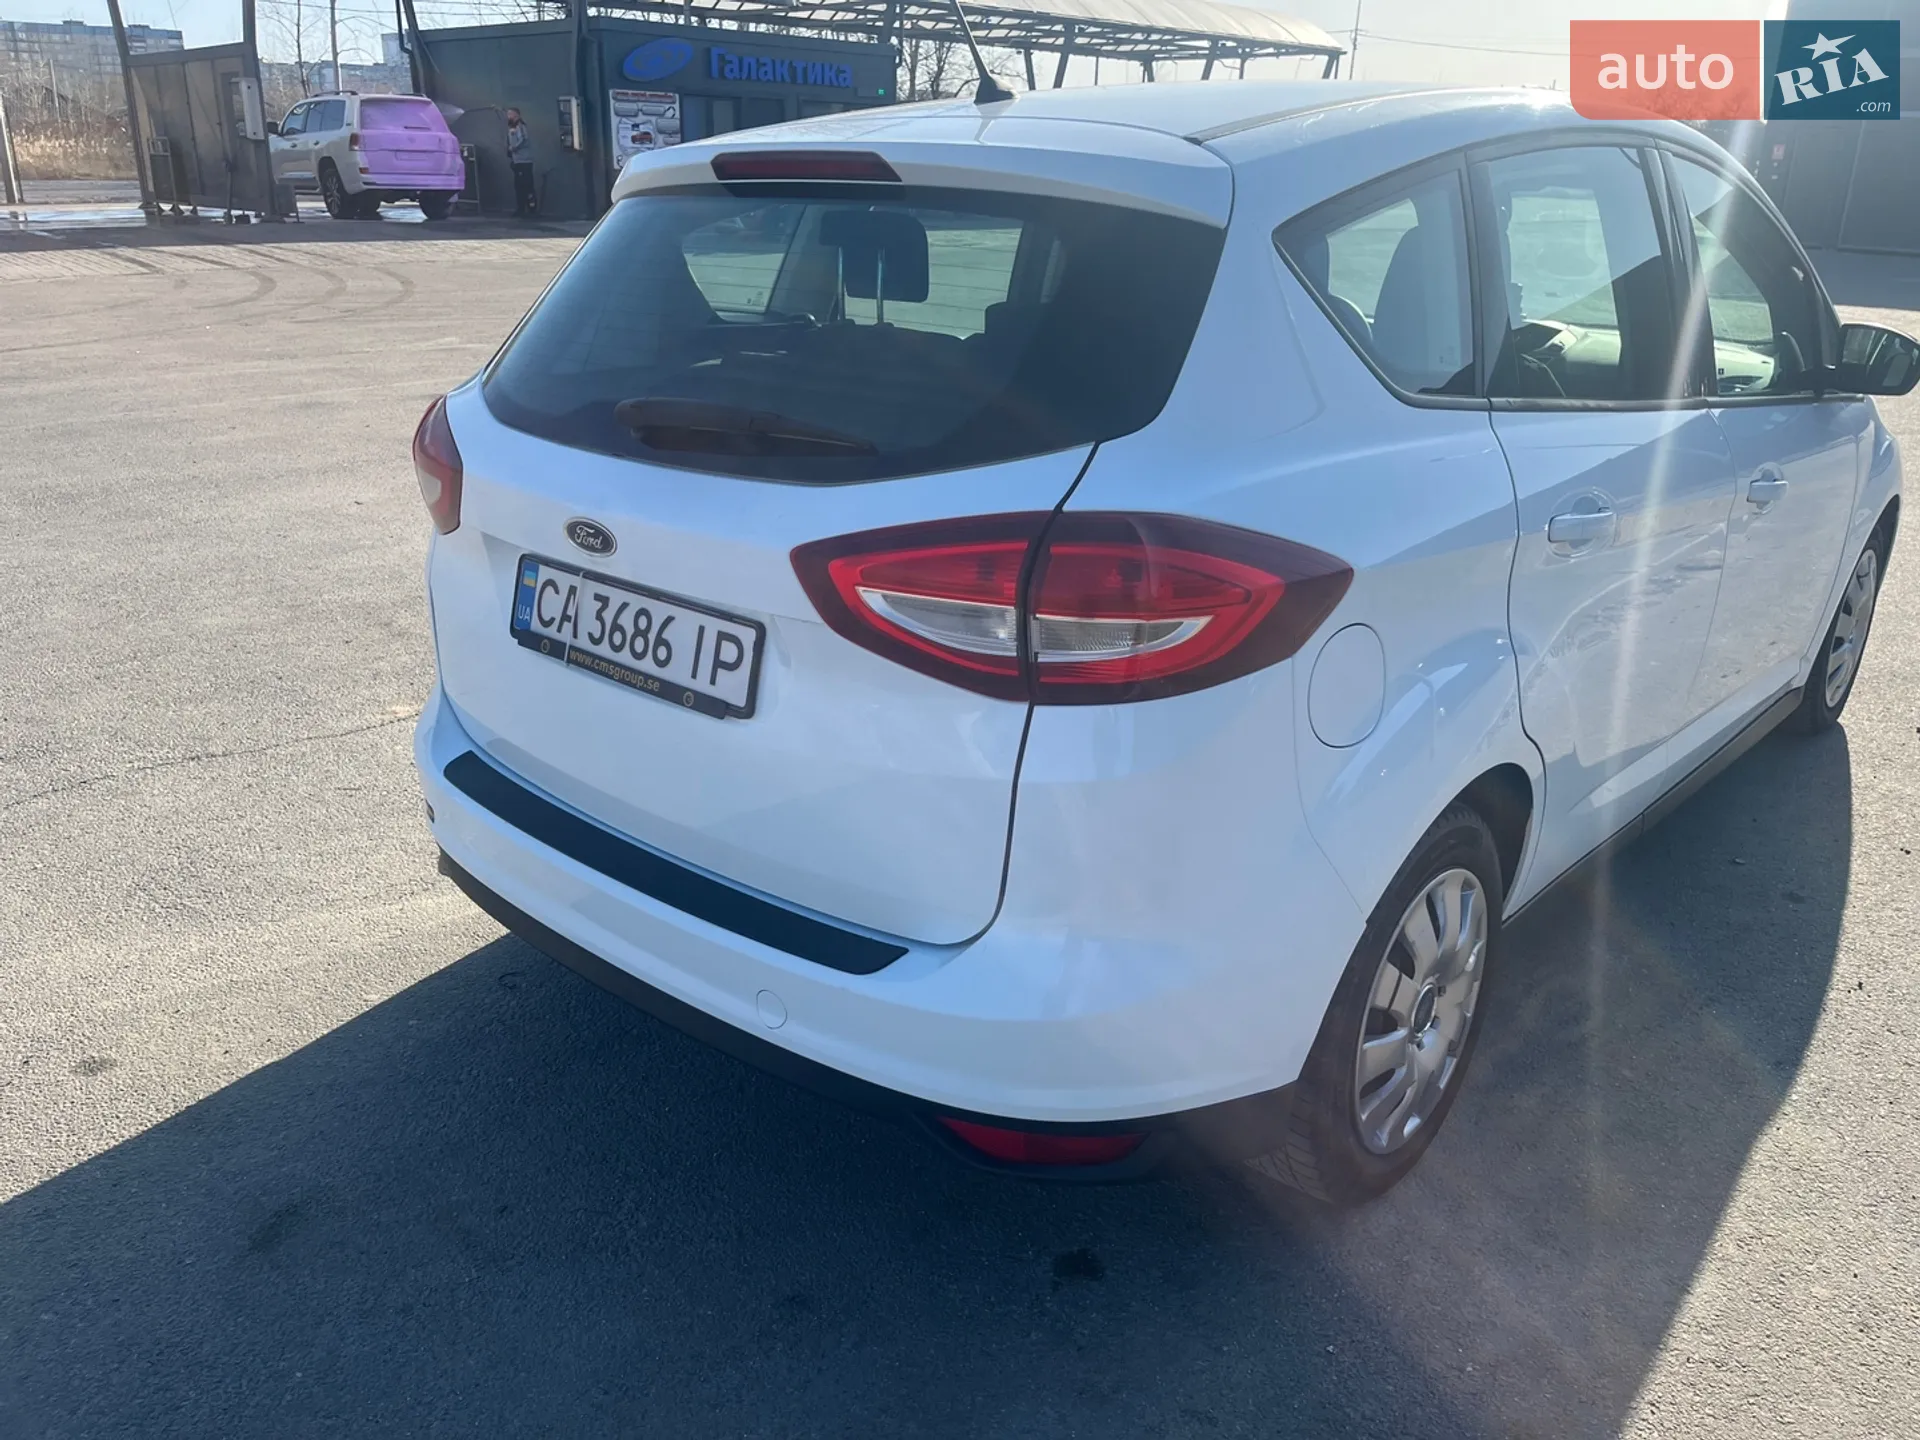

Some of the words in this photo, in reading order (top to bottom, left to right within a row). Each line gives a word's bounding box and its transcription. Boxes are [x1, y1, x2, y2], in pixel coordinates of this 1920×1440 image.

[709, 47, 854, 88] Галактика
[574, 525, 603, 549] Ford
[517, 604, 531, 623] UA
[537, 578, 579, 640] CA
[587, 592, 676, 669] 3686
[690, 624, 745, 686] IP
[569, 648, 661, 692] www.cmsgroup.se
